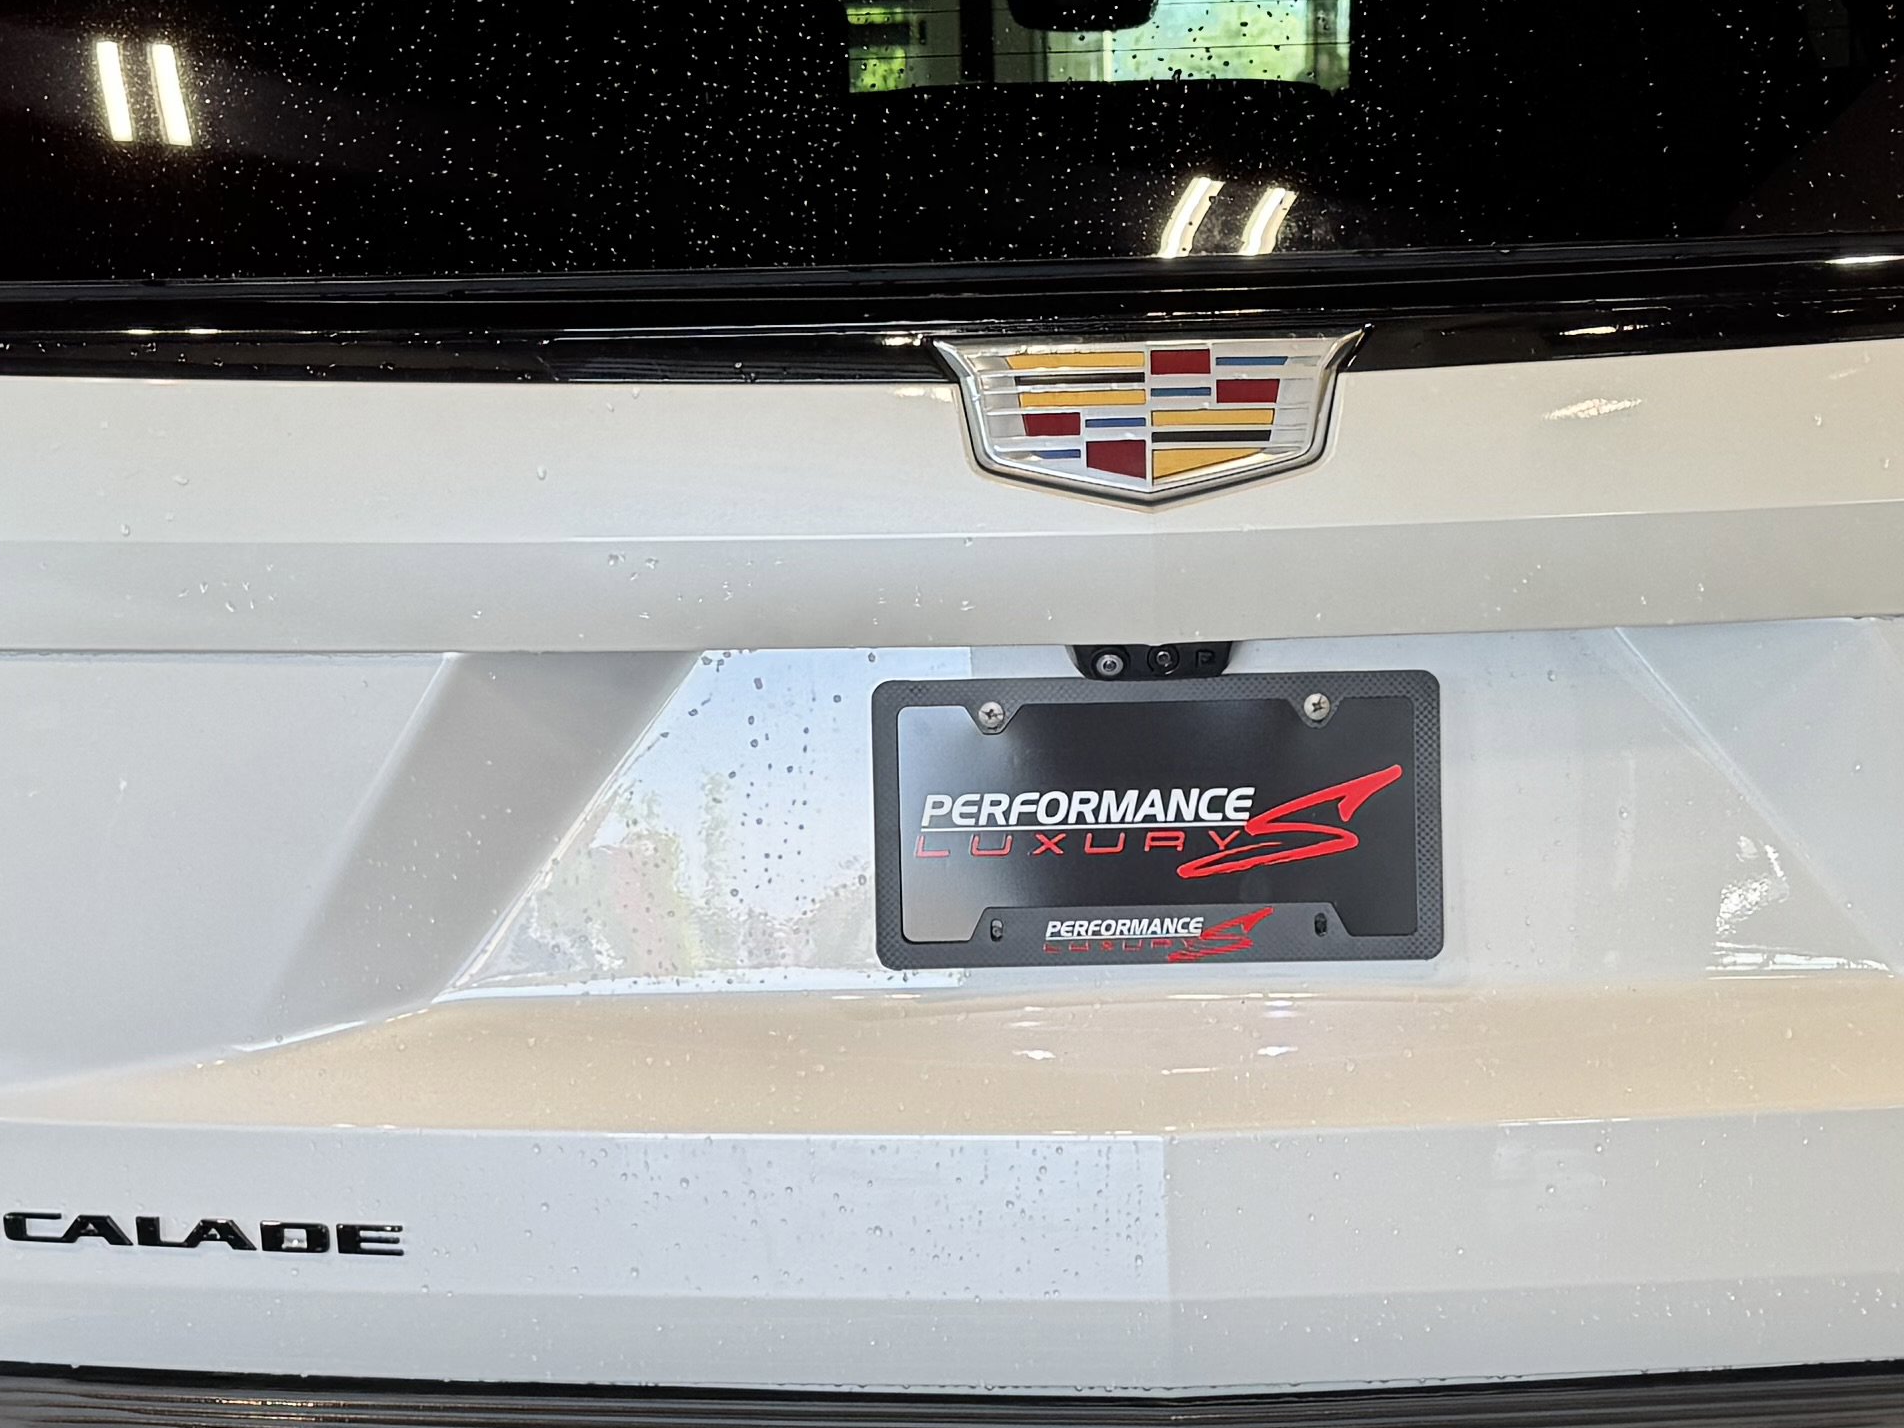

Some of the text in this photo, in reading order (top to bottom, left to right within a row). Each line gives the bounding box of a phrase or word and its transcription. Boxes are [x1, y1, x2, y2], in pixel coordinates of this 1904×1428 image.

[920, 786, 1256, 827] PERFORMANCE
[914, 829, 1242, 859] LUXURY
[1046, 916, 1205, 938] PERFORMANCE
